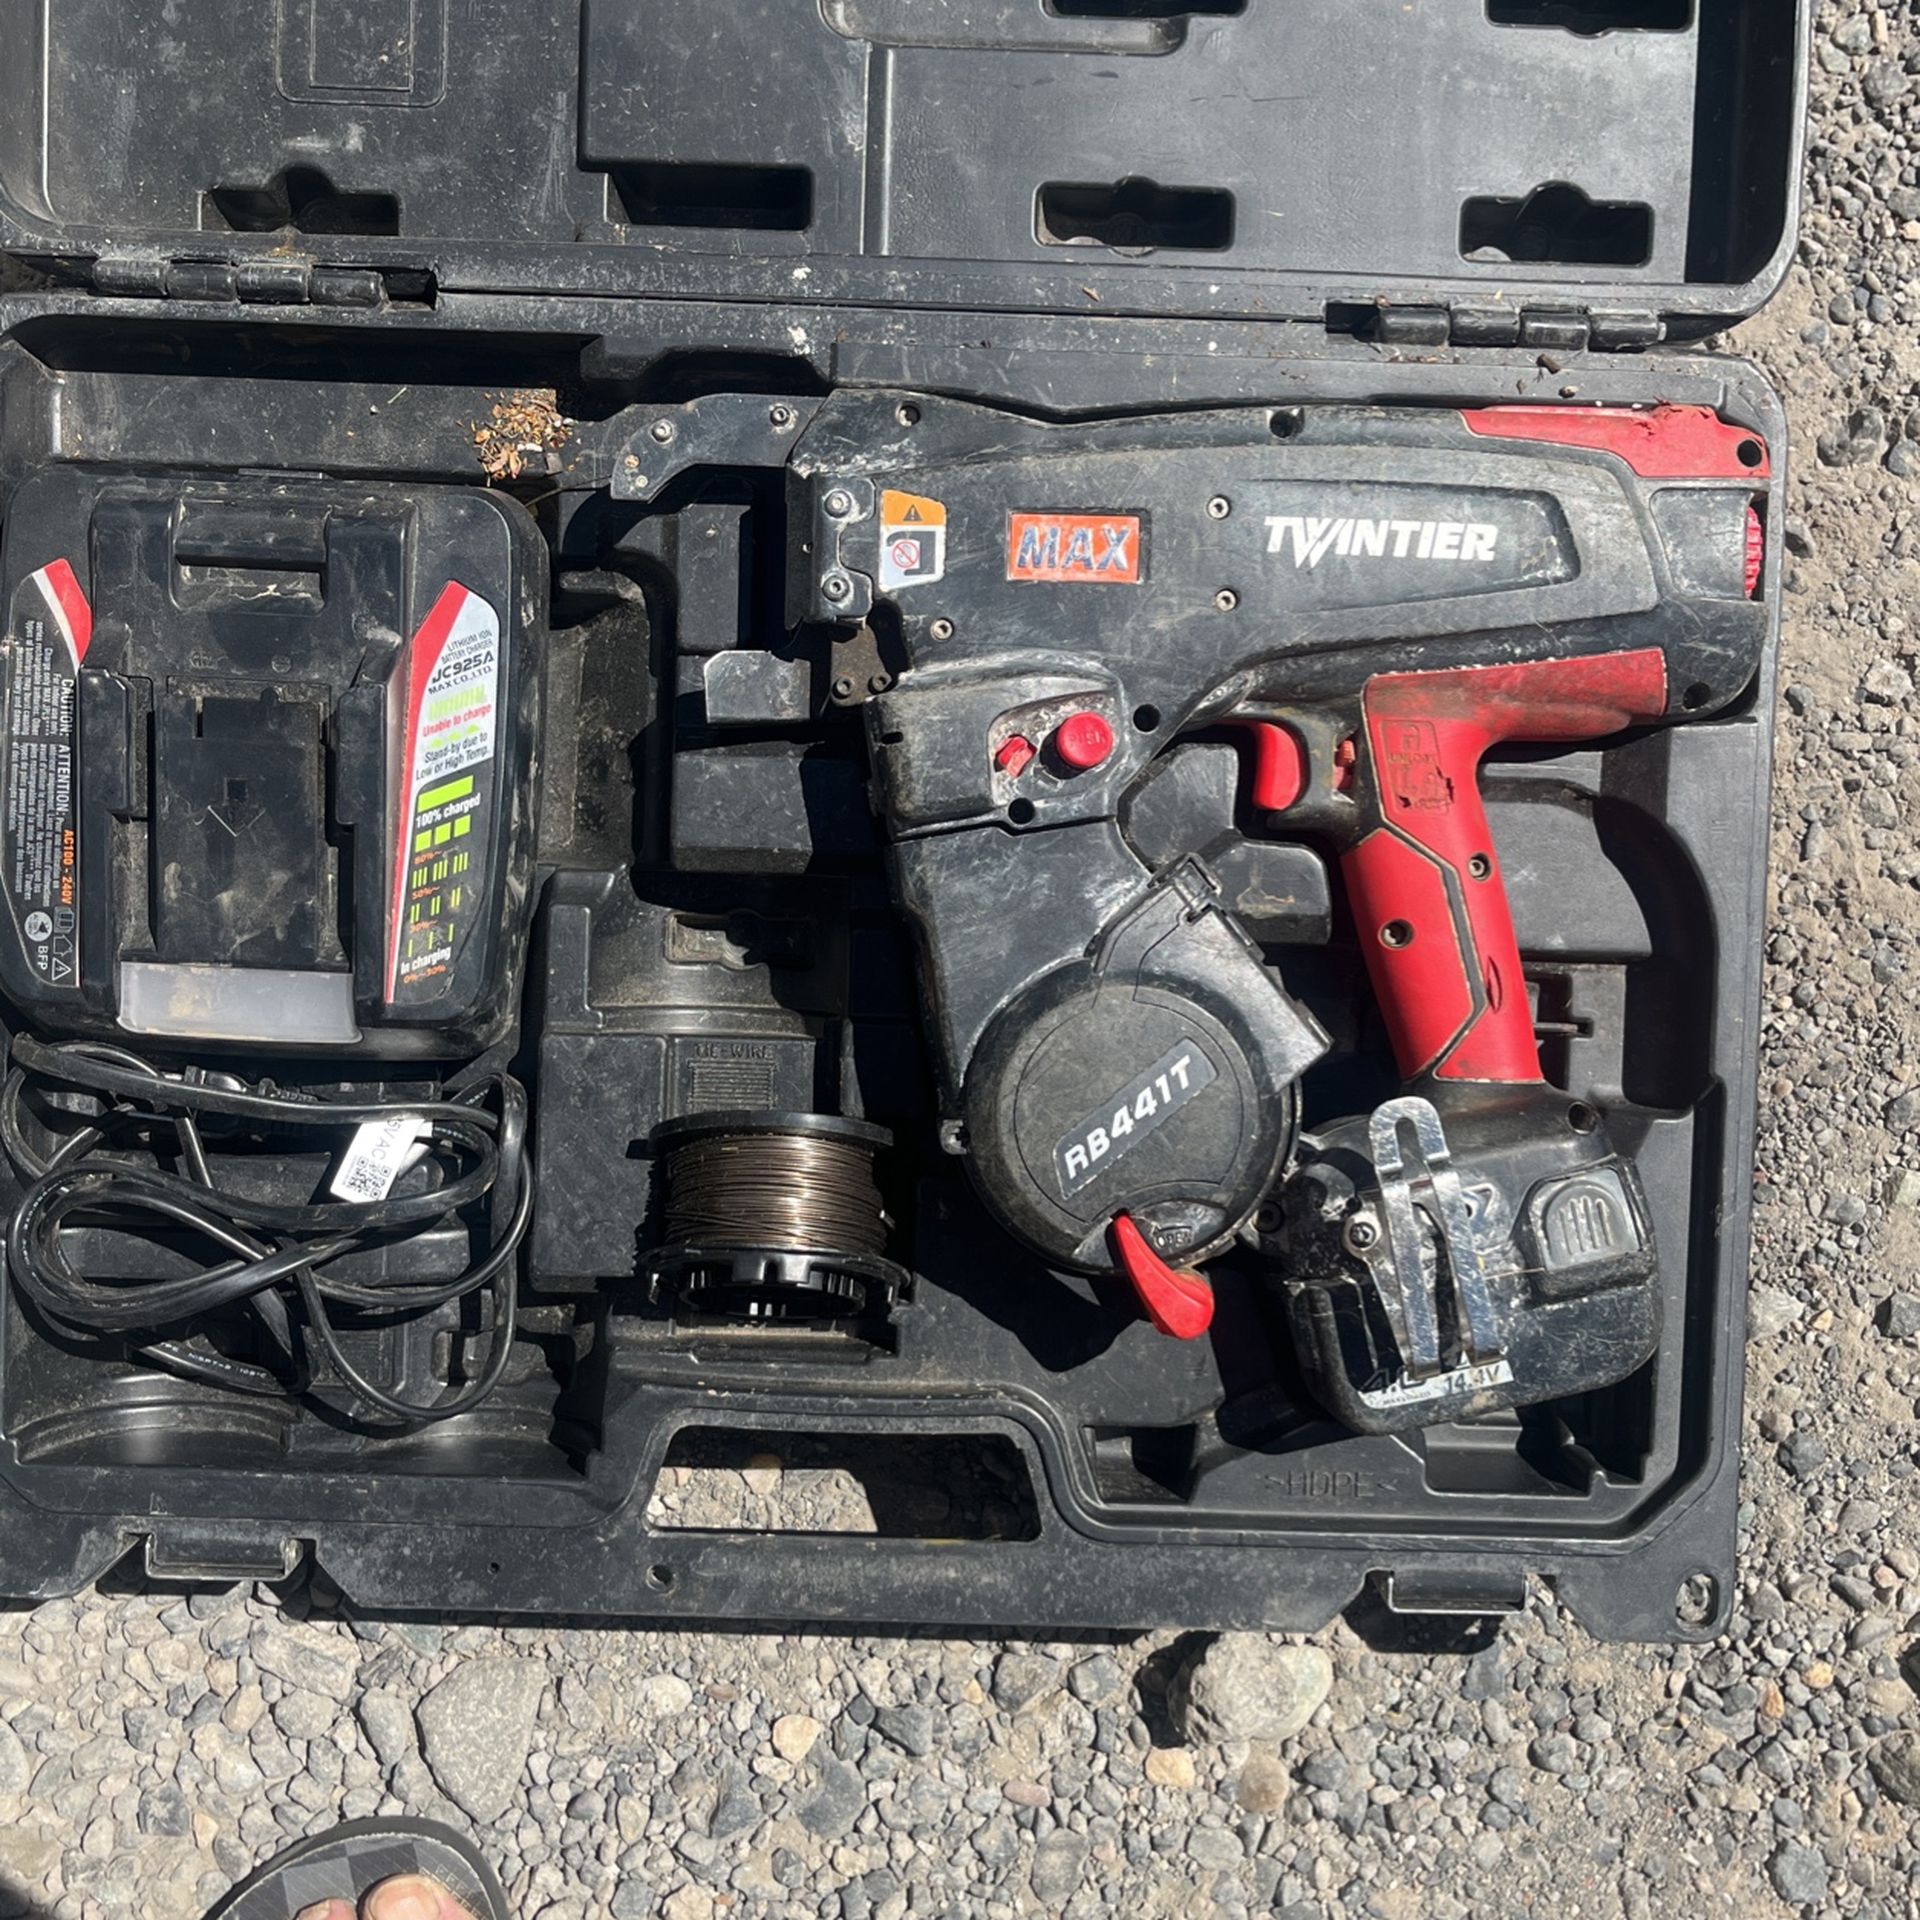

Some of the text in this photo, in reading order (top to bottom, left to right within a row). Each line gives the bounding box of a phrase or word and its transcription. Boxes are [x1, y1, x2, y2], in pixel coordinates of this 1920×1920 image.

[1017, 526, 1132, 571] MAX
[1264, 516, 1499, 568] TWINTIER
[442, 638, 493, 664] BATTERY CHARGER
[448, 629, 492, 651] LITHIUM ION
[432, 651, 494, 684] JC925A
[428, 680, 451, 695] MAX
[60, 679, 74, 736] CAUTION:
[423, 703, 492, 737] Unable to charge
[425, 732, 487, 763] Stand-by due to
[56, 744, 70, 815] ATTENTION:
[416, 764, 432, 780] Low
[434, 761, 443, 771] or
[445, 753, 464, 771] High
[416, 793, 481, 828] 100% charged
[64, 830, 74, 865] AC100
[62, 876, 72, 904] 240V
[37, 945, 48, 970] BFP
[401, 947, 451, 975] In charging
[1064, 1054, 1191, 1179] RB441T
[372, 1137, 391, 1160] AC
